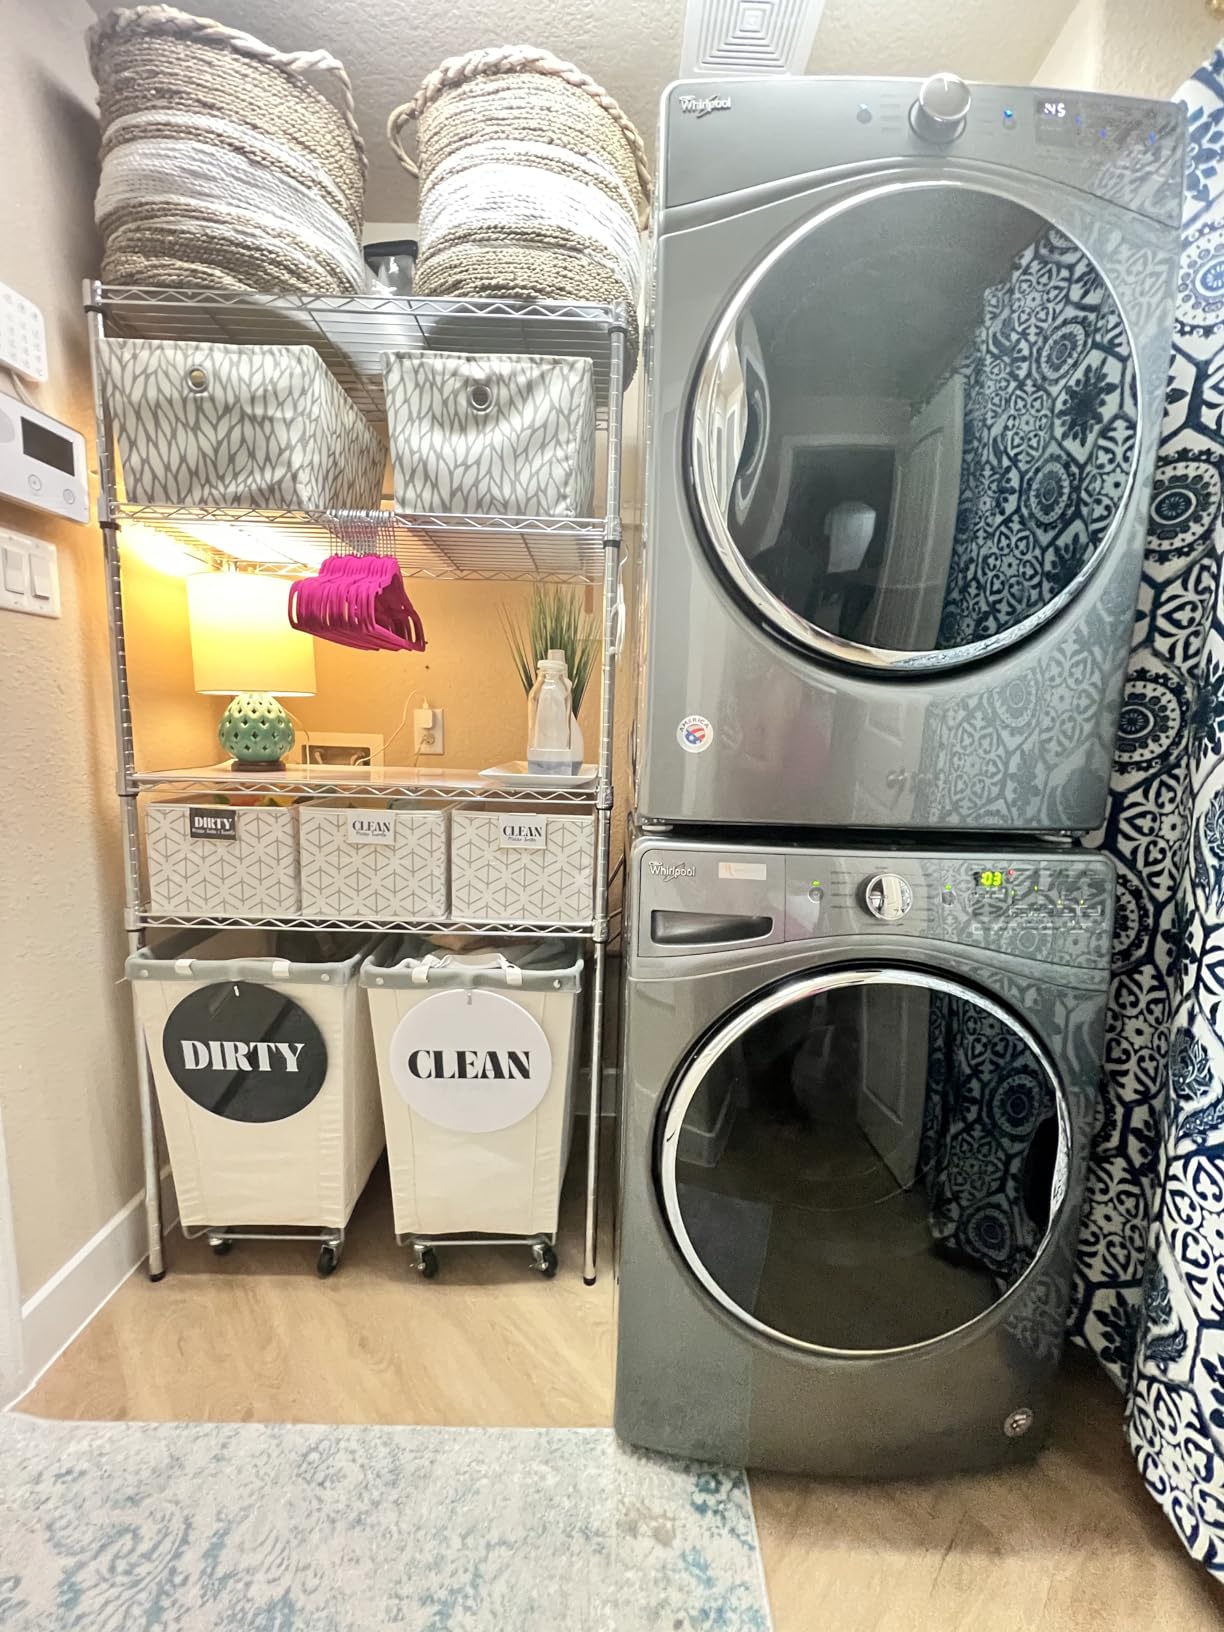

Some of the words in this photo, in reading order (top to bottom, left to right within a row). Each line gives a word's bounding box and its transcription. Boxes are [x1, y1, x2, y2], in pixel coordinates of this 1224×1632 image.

[680, 96, 731, 114] Whirlpool
[194, 816, 232, 830] DIRTY
[352, 820, 391, 832] CLEAN
[502, 825, 542, 837] CLEAN
[649, 861, 696, 880] Whirlpool
[180, 1040, 305, 1072] DIRTY
[407, 1049, 531, 1079] CLEAN
